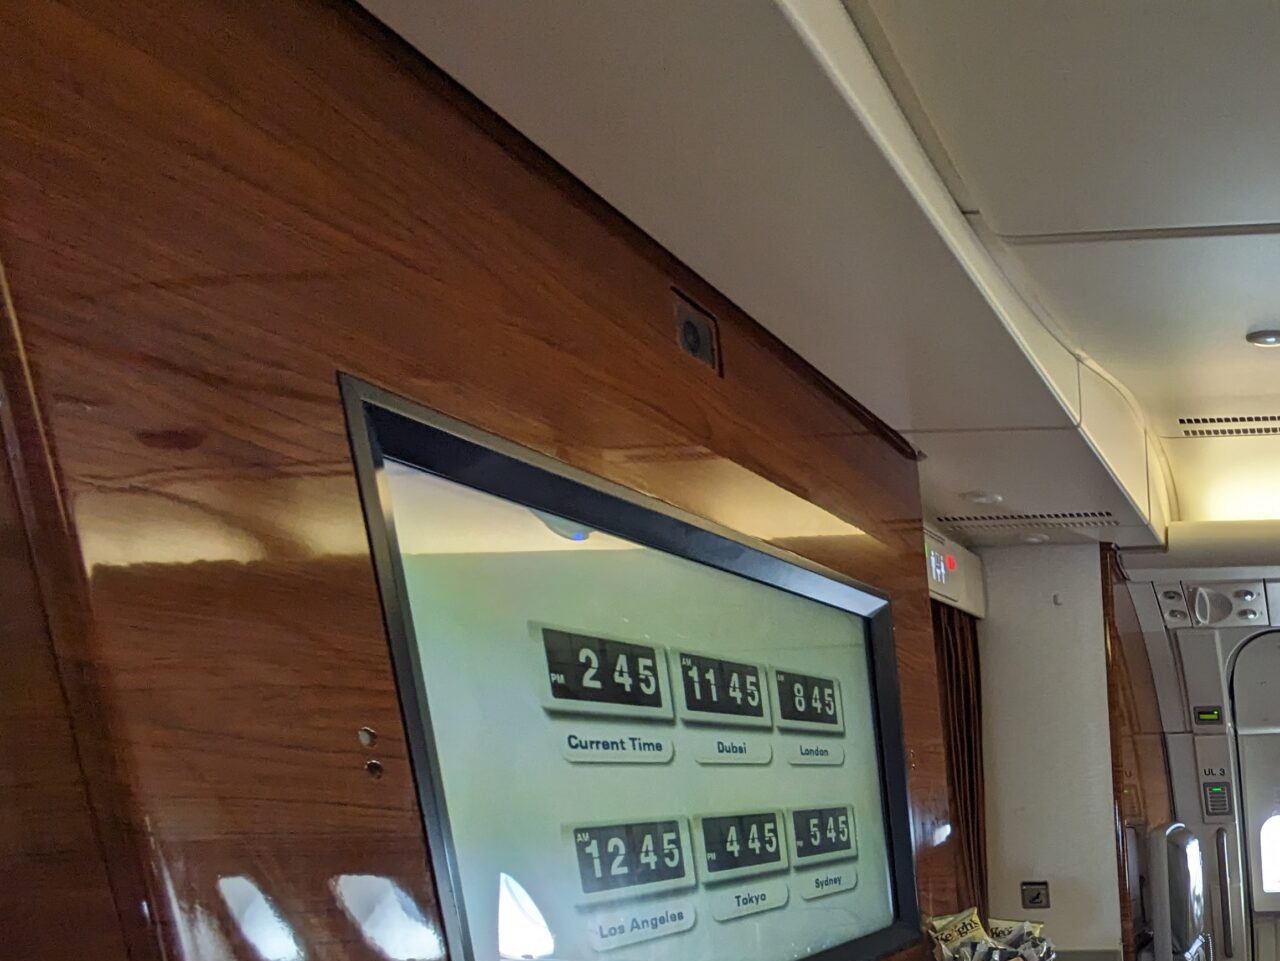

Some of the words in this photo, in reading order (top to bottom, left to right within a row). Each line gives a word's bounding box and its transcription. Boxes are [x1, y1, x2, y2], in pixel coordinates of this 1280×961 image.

[567, 734, 626, 751] Current
[628, 737, 663, 752] Time
[717, 741, 747, 754] Dubai
[800, 745, 829, 757] London
[1204, 768, 1216, 776] UL
[1219, 768, 1226, 776] 3
[815, 876, 842, 889] Sydney
[735, 893, 767, 907] Tokyo
[599, 924, 625, 939] Los
[630, 911, 684, 932] Angeles
